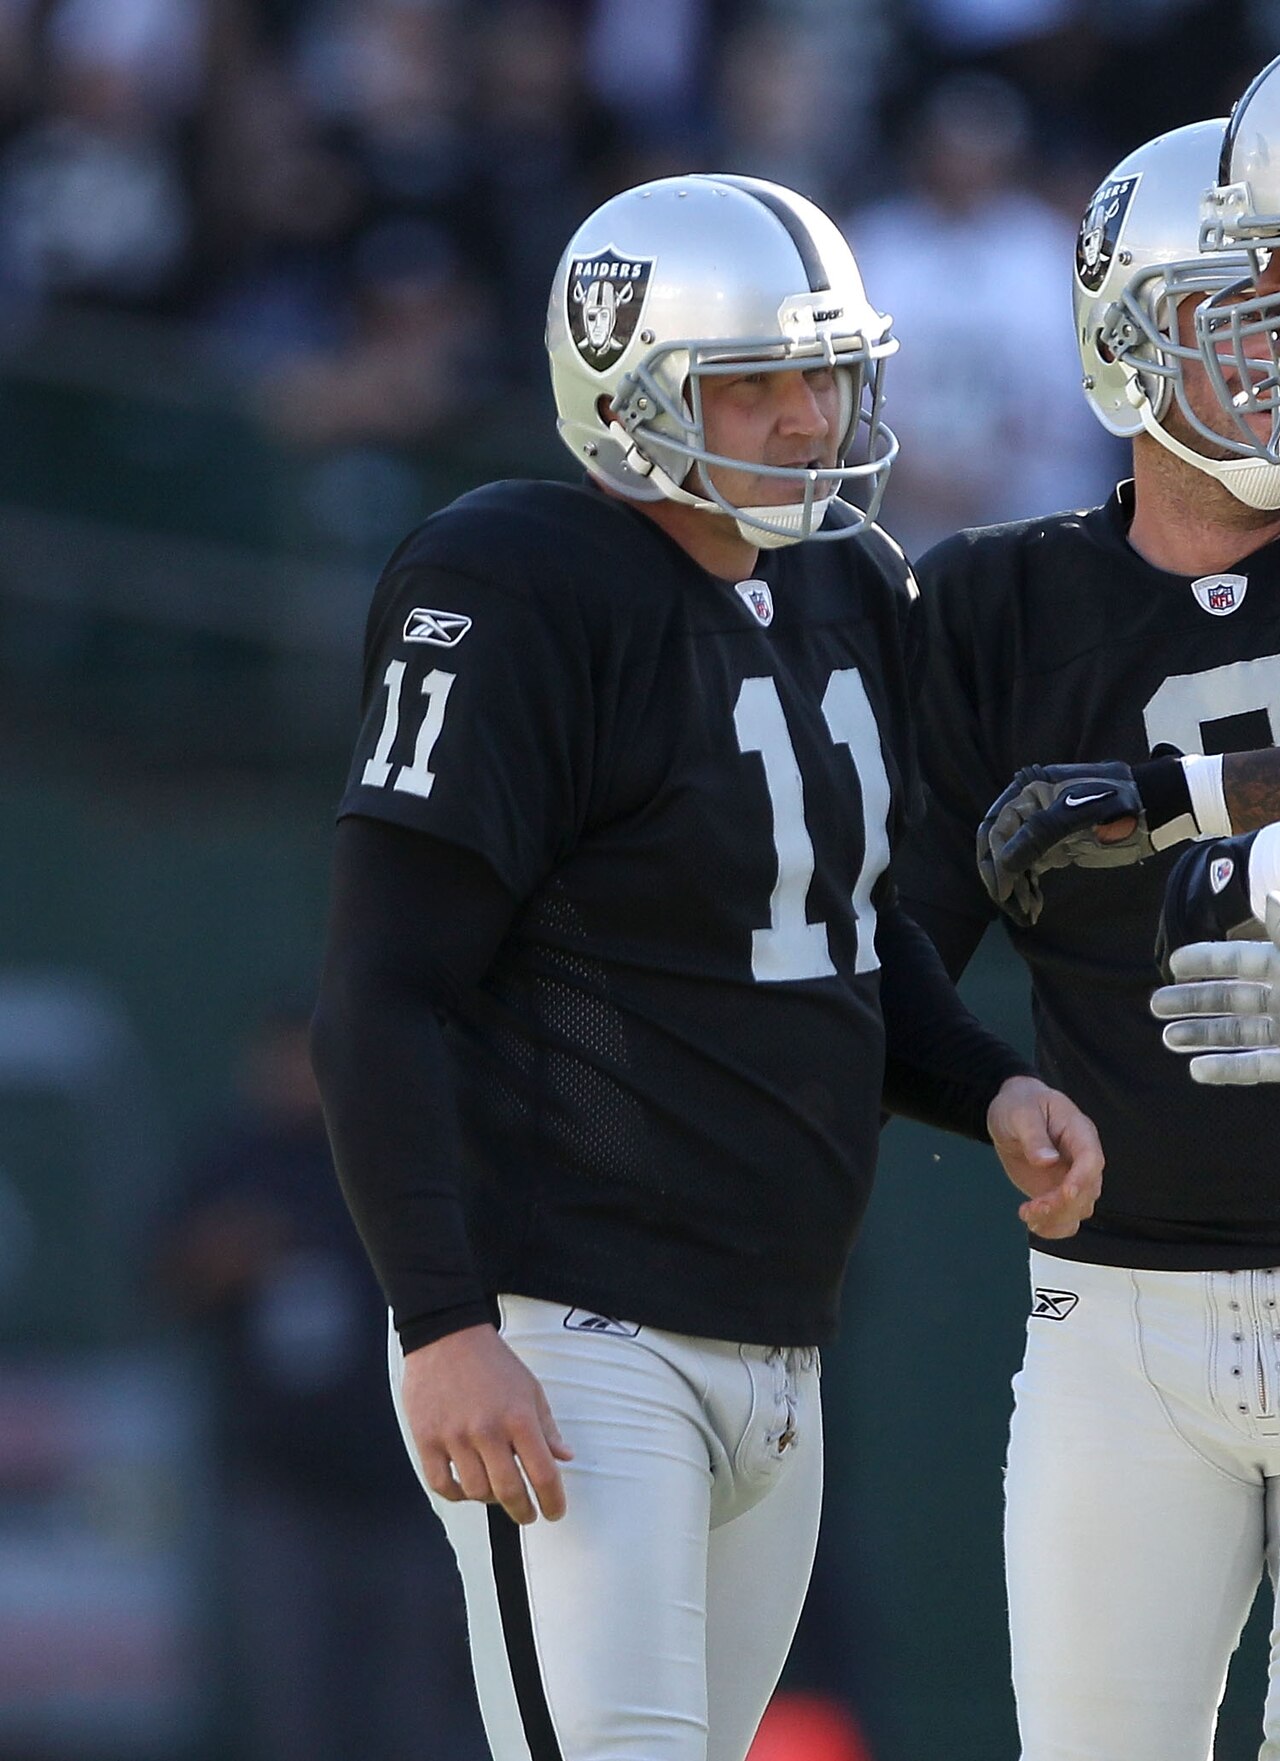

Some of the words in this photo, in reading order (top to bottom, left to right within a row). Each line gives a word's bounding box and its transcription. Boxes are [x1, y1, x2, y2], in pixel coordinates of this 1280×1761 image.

[1094, 181, 1131, 204] DERS
[574, 261, 642, 278] RAIDERS
[812, 307, 845, 322] AIDERS
[361, 659, 457, 799] 11
[733, 666, 891, 982] 11
